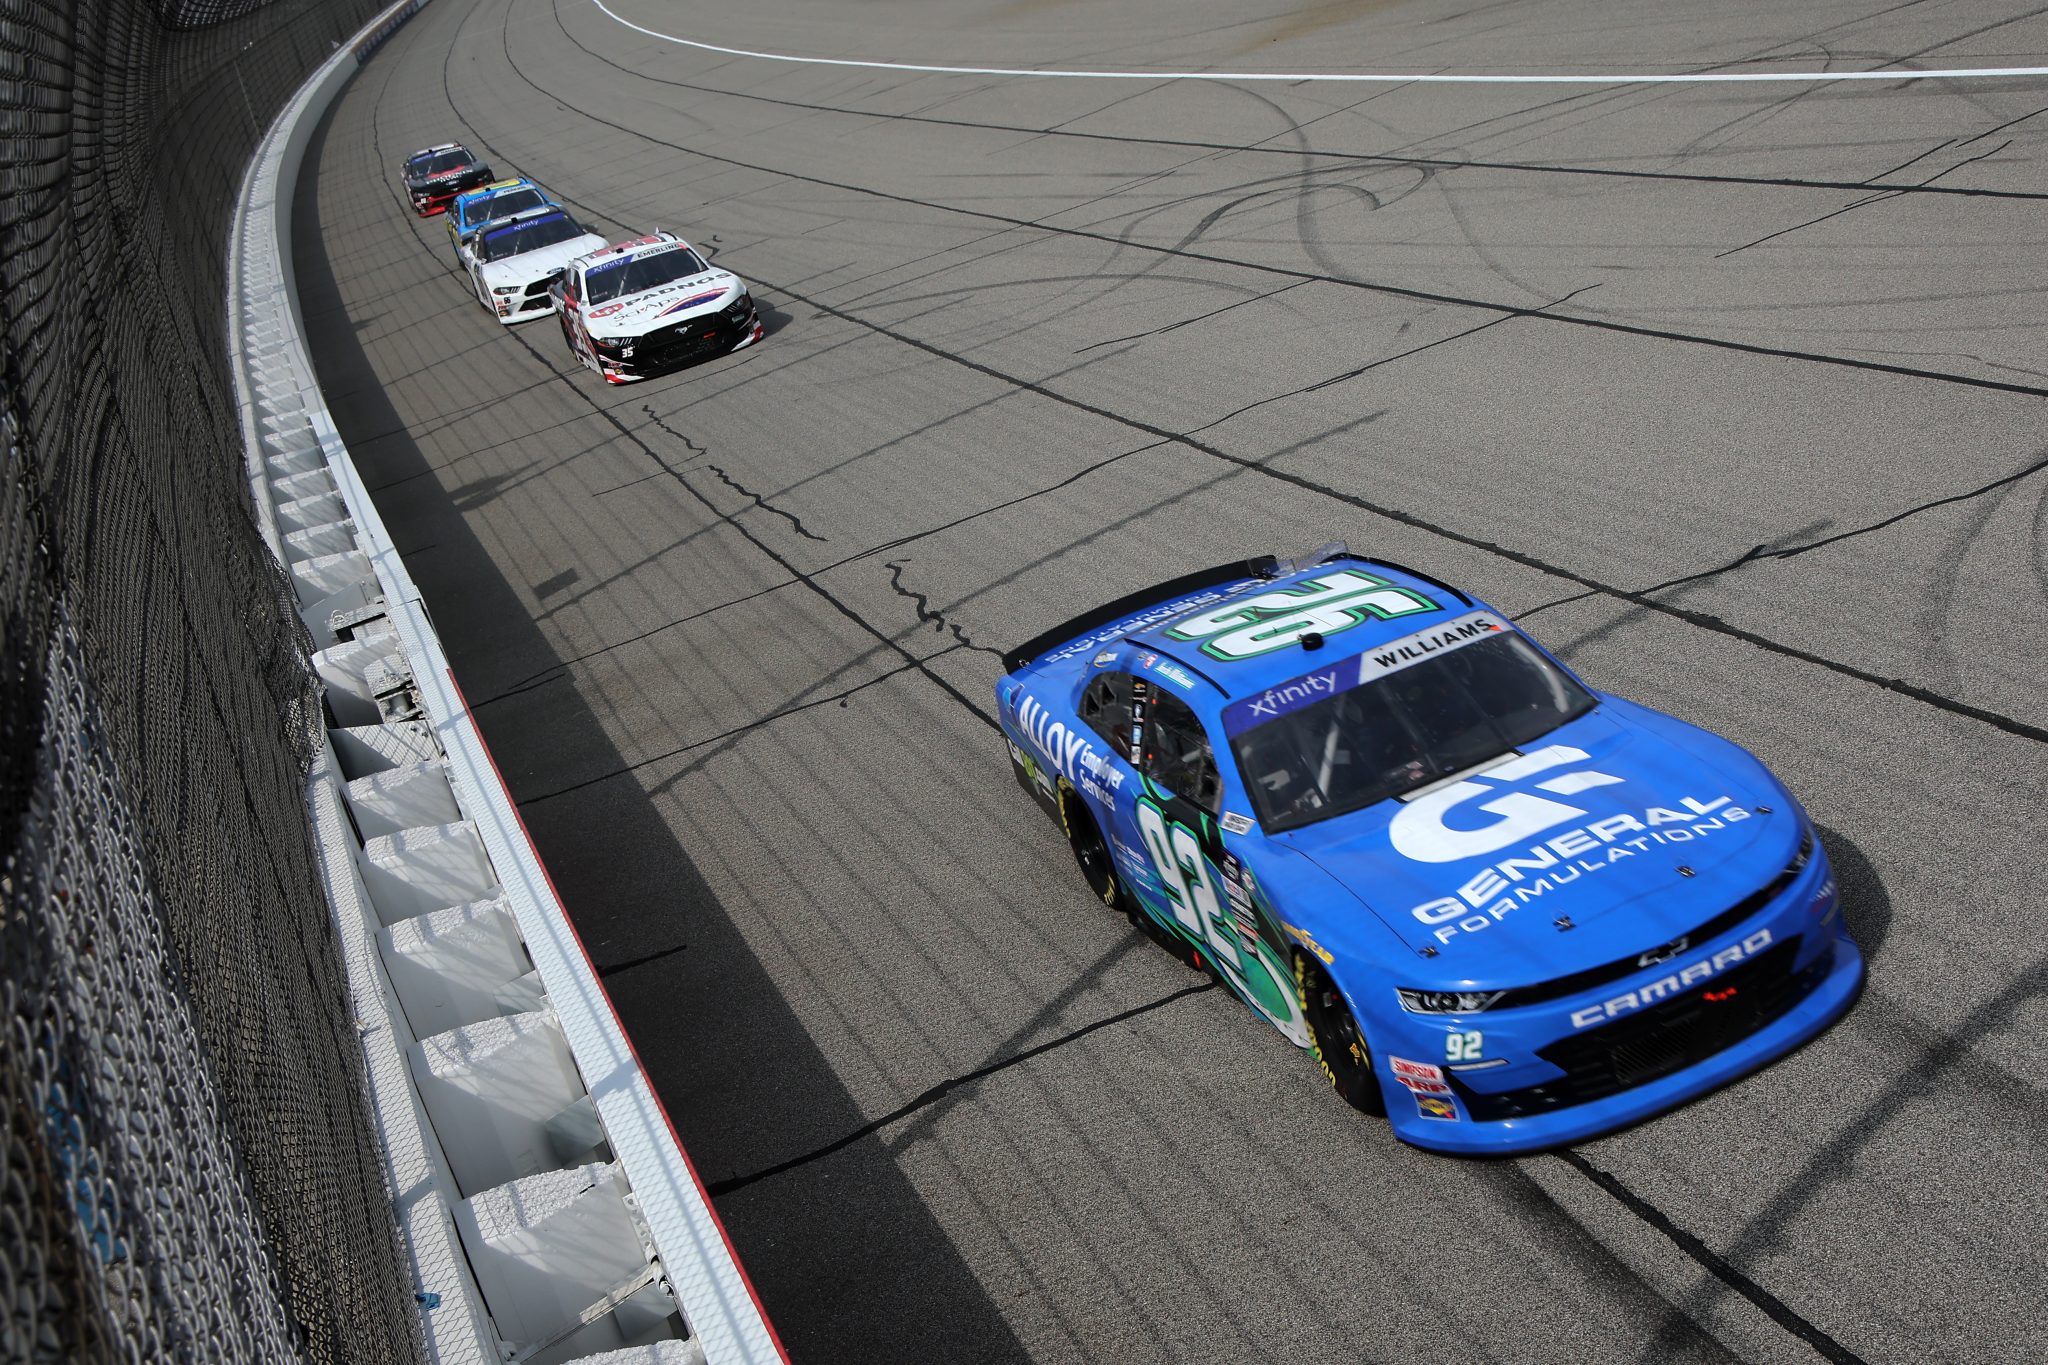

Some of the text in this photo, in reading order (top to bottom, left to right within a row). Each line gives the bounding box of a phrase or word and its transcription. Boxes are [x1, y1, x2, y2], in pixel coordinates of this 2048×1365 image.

[513, 219, 540, 231] xfinity
[593, 258, 625, 273] xfinity
[624, 272, 732, 307] PADNOS
[621, 346, 634, 359] 35
[1160, 568, 1445, 662] 92
[1373, 619, 1494, 668] WILLIAMS
[1247, 671, 1337, 717] xfinity
[1019, 694, 1087, 782] ALLOY
[1080, 742, 1126, 790] Employer
[1080, 767, 1117, 813] Services
[1411, 796, 1733, 926] GENERAL
[1433, 807, 1752, 946] FORMULATIONS
[1137, 795, 1247, 978] 92
[1570, 928, 1773, 1029] CAMARO
[1394, 1059, 1439, 1080] SIMPSON
[1445, 1030, 1483, 1062] 92
